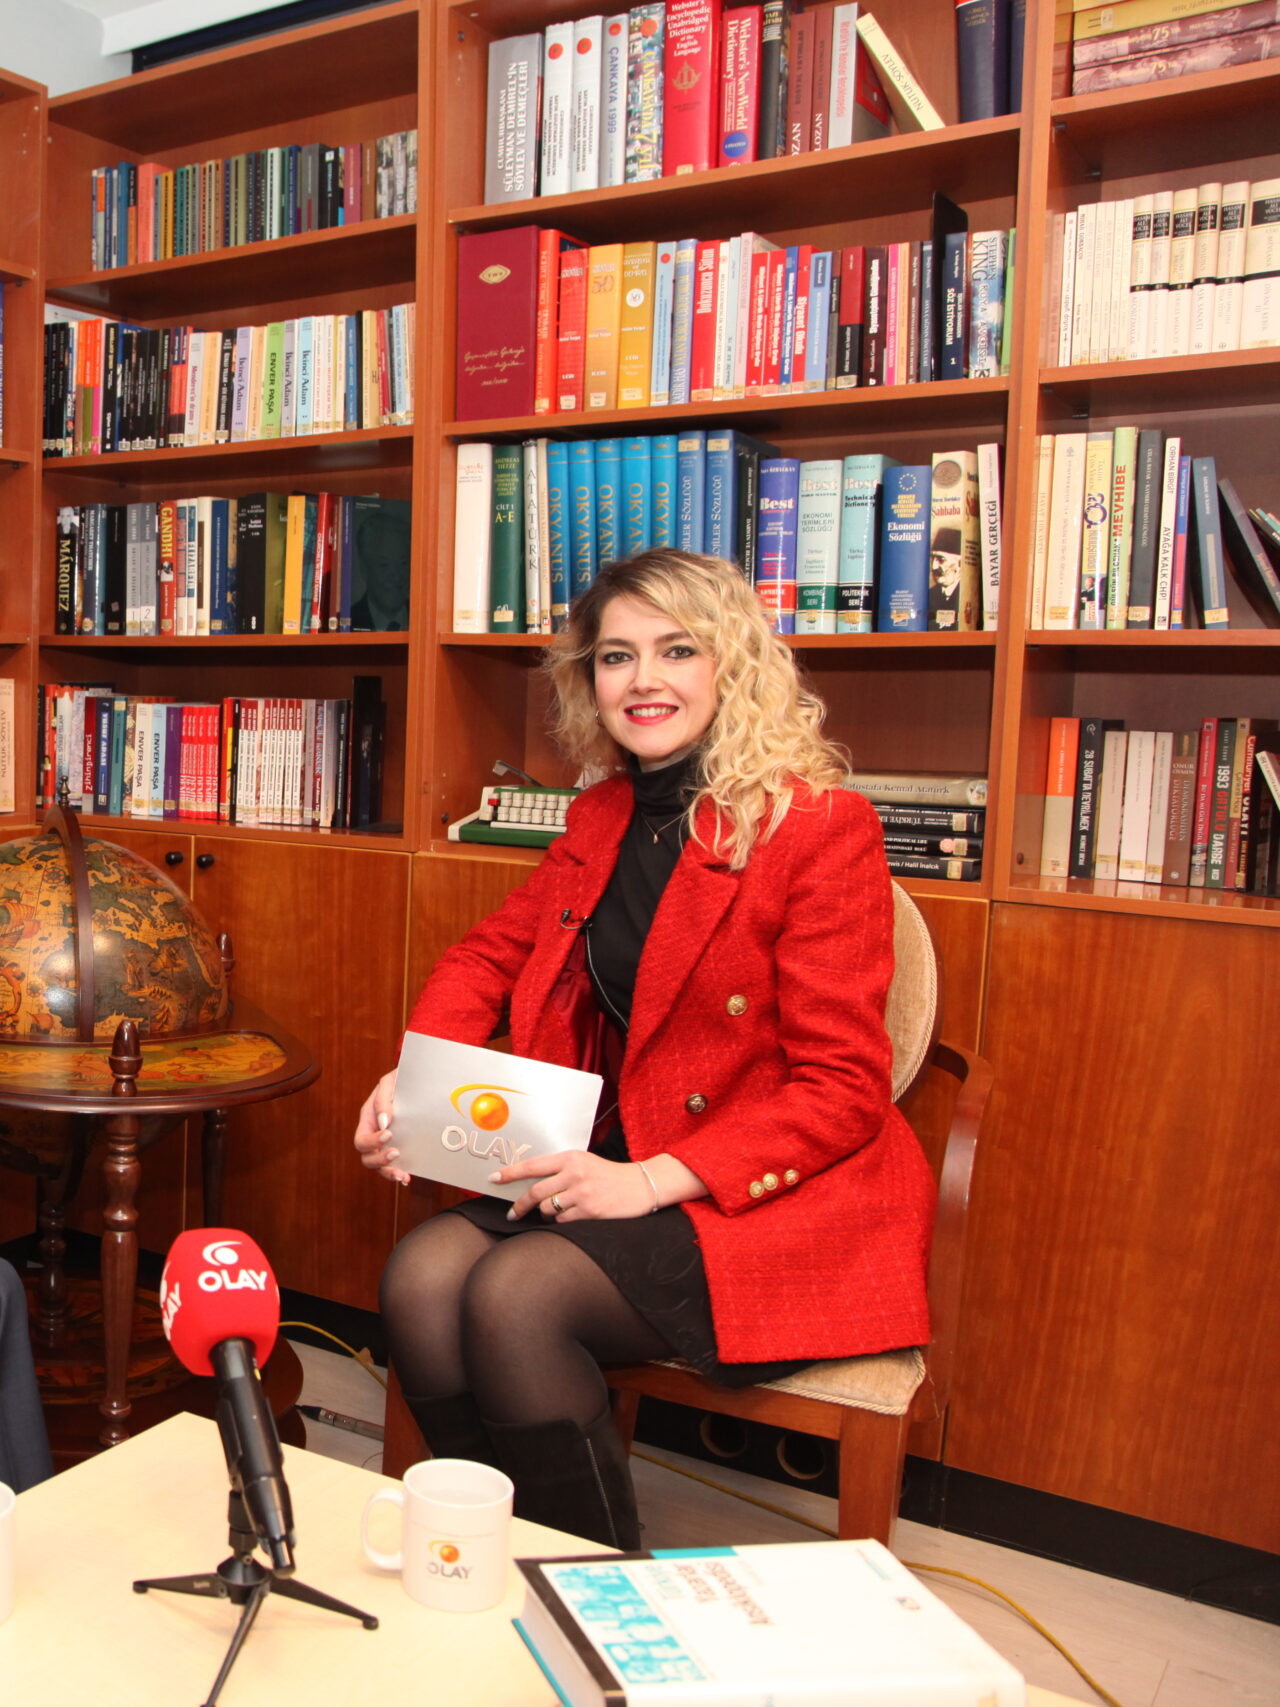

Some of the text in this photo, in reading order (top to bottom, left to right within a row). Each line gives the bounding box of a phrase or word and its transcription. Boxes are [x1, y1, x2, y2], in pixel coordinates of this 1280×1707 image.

[666, 6, 711, 22] Encyclopedic
[667, 15, 709, 30] Unabridged
[669, 24, 706, 38] Dictionary
[676, 40, 698, 50] English
[723, 19, 739, 80] Dictionary
[1151, 26, 1170, 41] 75
[673, 46, 701, 57] Language
[607, 47, 620, 103] ÇANKAYA
[736, 17, 752, 130] Webster's New World
[514, 60, 529, 192] SÖYLEV VE DEMEÇLERİ
[633, 129, 658, 144] 7
[503, 132, 515, 193] SÜLEYMAN
[635, 146, 655, 170] yıl
[972, 239, 988, 281] KING
[987, 237, 998, 281] STEPHEN
[696, 271, 714, 314] Dokuzuncu
[794, 296, 808, 355] Siyaset Okulu
[945, 288, 956, 345] SÖZ İSTİYORUM
[237, 357, 247, 383] İkinci
[284, 352, 294, 378] İkinci
[300, 350, 311, 406] İkinci Adam
[1167, 445, 1177, 471] ORHAN
[681, 475, 692, 521] SÖZLÜĞÜ
[711, 475, 722, 521] SÖZLÜĞÜ
[801, 479, 838, 492] Best
[844, 477, 880, 491] Best
[628, 482, 643, 554] OKYAN
[760, 497, 795, 511] Best
[931, 505, 961, 519] Şahbaba
[161, 507, 174, 558] GANDHI
[549, 487, 563, 583] OKYANUS
[575, 486, 590, 583] OKYANUS
[598, 484, 613, 569] OKYANU
[887, 521, 925, 532] Ekonomi
[888, 532, 922, 543] Sözlüğü
[986, 500, 999, 587] BAYAR GERÇEĞİ
[58, 539, 74, 612] MÁRQUEZ
[1159, 527, 1173, 600] AYAĞA KALK CHP!
[150, 765, 160, 790] PAŞA
[850, 782, 881, 792] Mustafa
[1217, 765, 1230, 789] 1993
[1079, 792, 1092, 831] DEVRİLMEK
[1210, 833, 1227, 865] DARBE
[441, 1125, 533, 1166] OLAY
[198, 1269, 267, 1293] OLAY
[427, 1562, 473, 1580] OLAY
